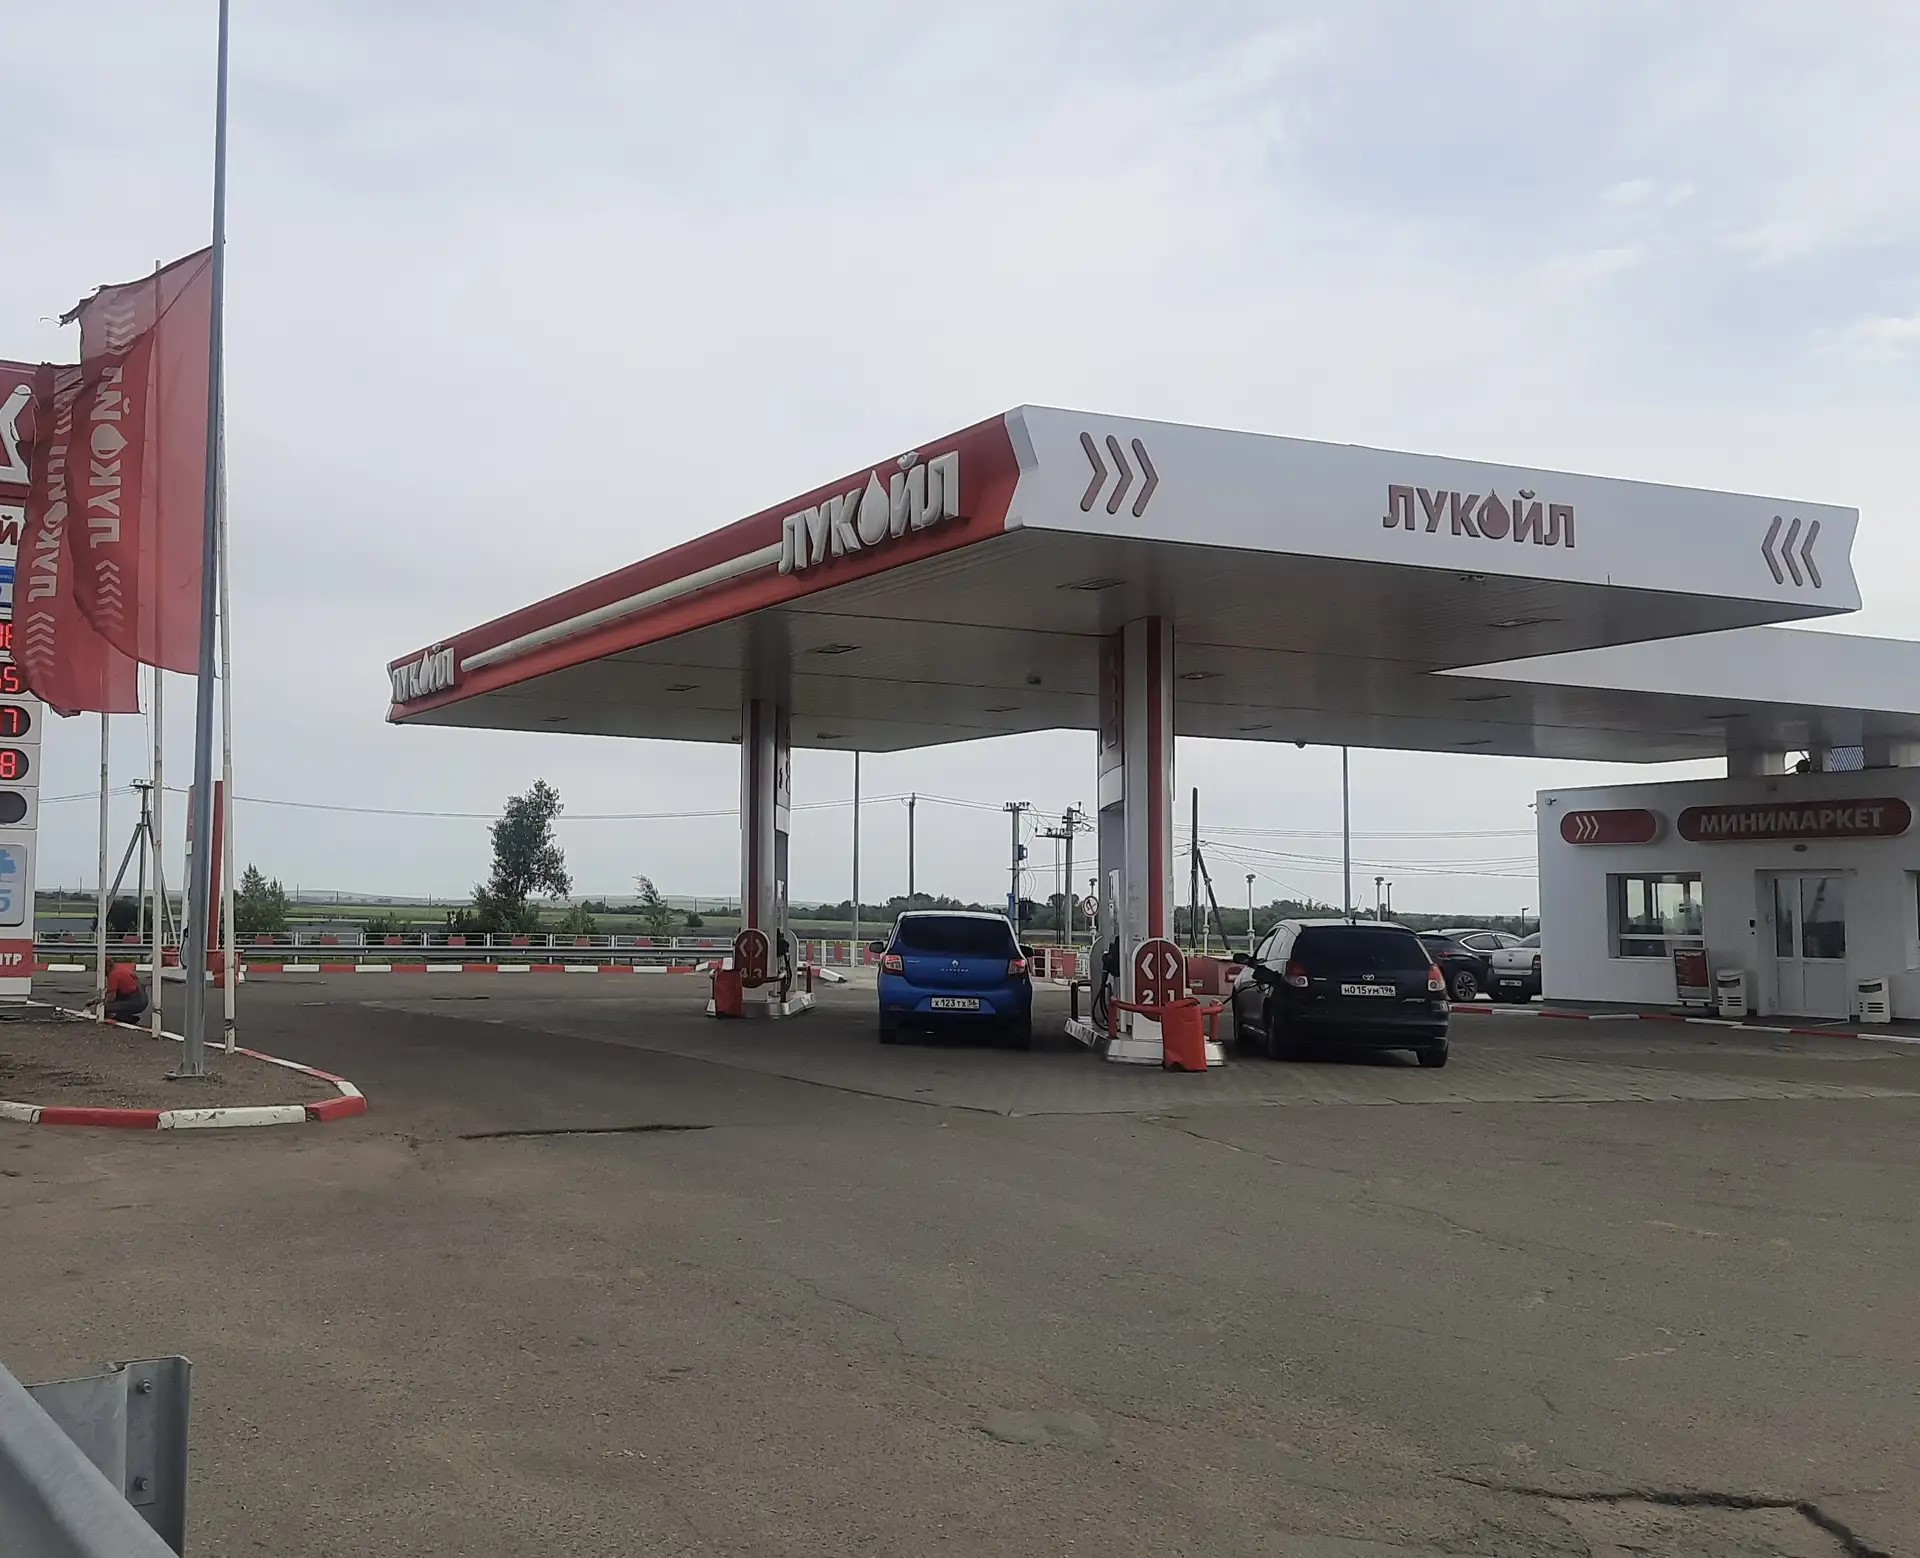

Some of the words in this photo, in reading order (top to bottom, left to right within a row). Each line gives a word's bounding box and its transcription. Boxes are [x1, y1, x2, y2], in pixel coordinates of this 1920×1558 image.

[778, 450, 959, 577] ЛУКОЙЛ
[1382, 483, 1575, 549] ЛУКОЙЛ
[391, 643, 455, 704] ЛУКОЙЛ
[1700, 807, 1884, 833] МИНИМАРКЕТ
[1142, 989, 1154, 1005] 2
[1167, 989, 1176, 1002] 1
